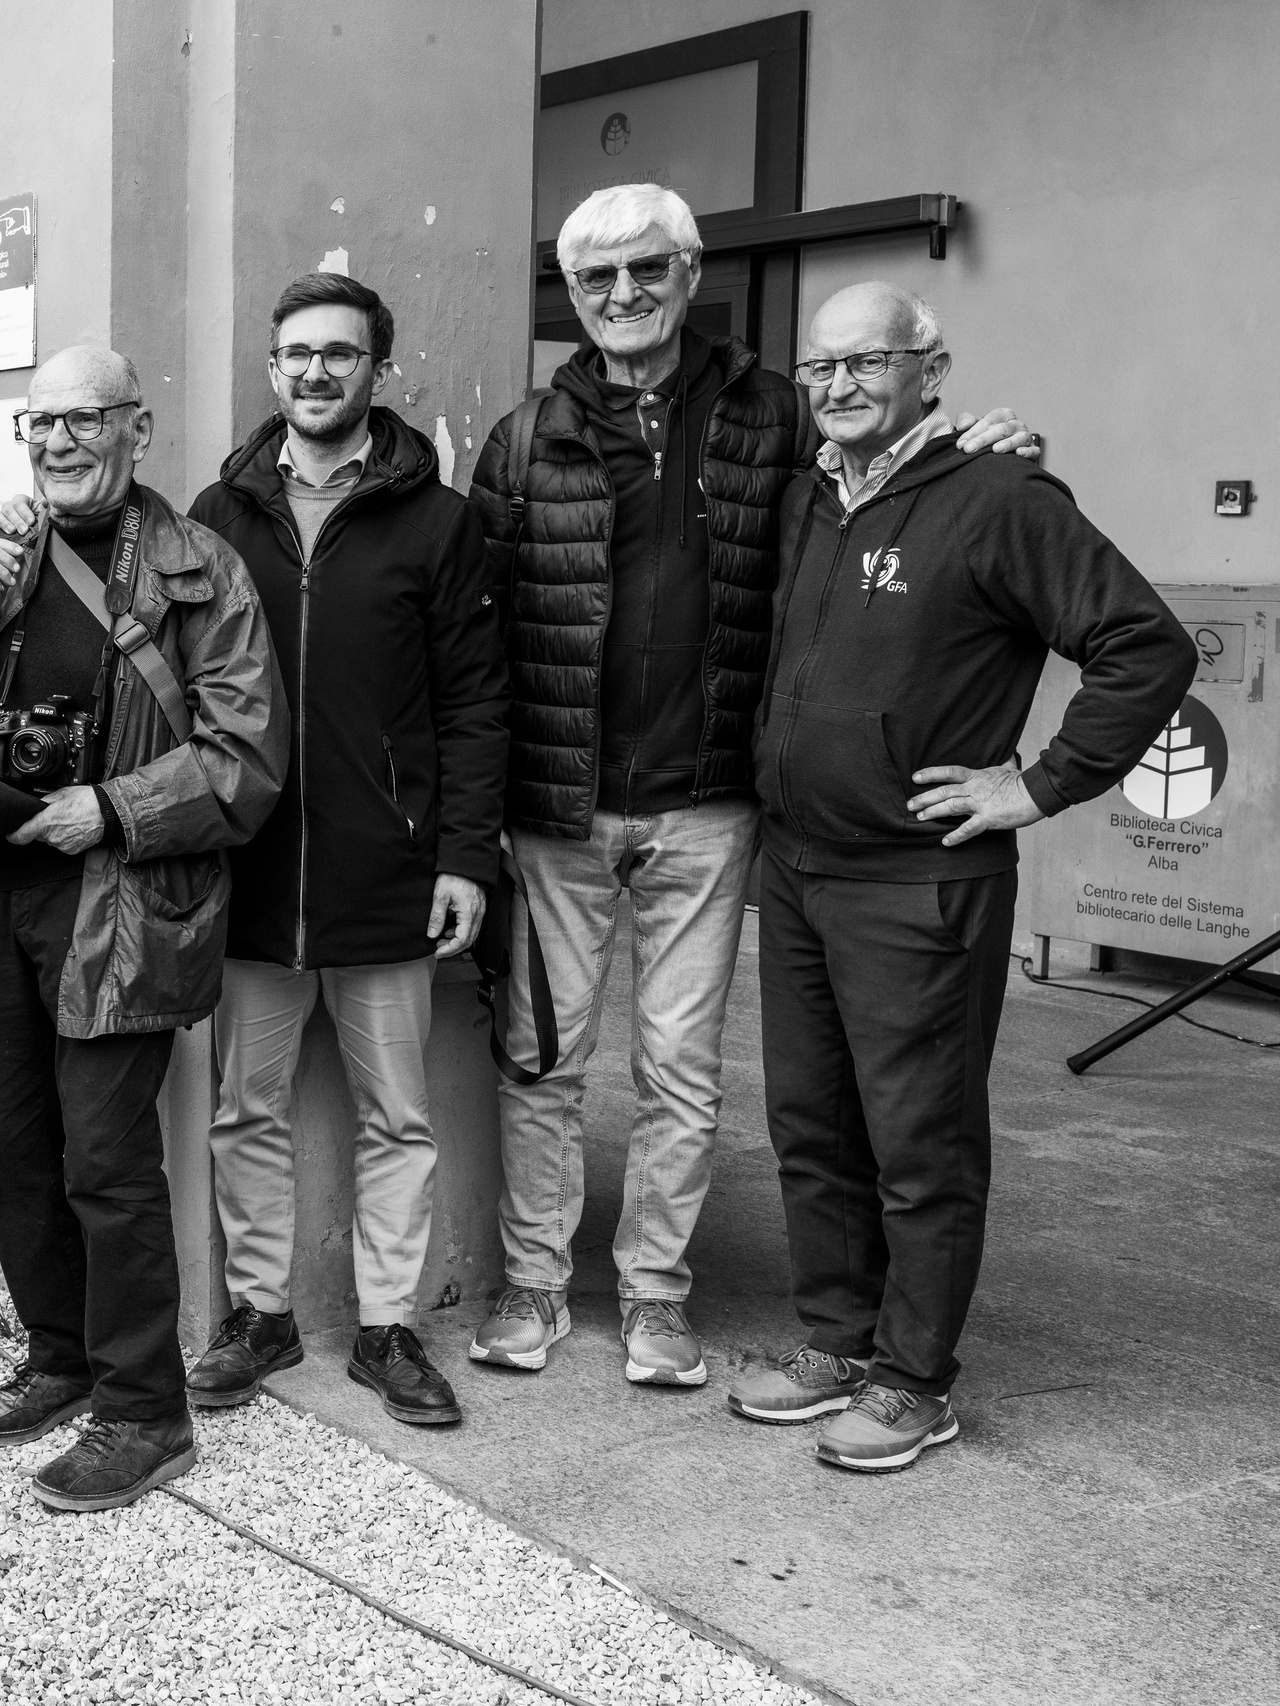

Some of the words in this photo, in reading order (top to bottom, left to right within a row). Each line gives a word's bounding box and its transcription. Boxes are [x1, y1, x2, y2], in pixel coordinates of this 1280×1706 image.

[121, 505, 141, 541] D800
[115, 542, 134, 583] Nikon
[886, 580, 907, 594] GFA
[34, 707, 54, 715] Nikon
[1110, 813, 1175, 833] Biblioteca
[1179, 820, 1223, 838] Civica
[1147, 855, 1179, 871] Alba
[1083, 883, 1128, 902] Centro
[1131, 891, 1158, 906] rete
[1161, 894, 1183, 910] del
[1186, 897, 1244, 918] Sistema
[1076, 900, 1156, 924] bibliotecario
[1159, 913, 1192, 930] delle
[1196, 917, 1250, 939] Langhe
